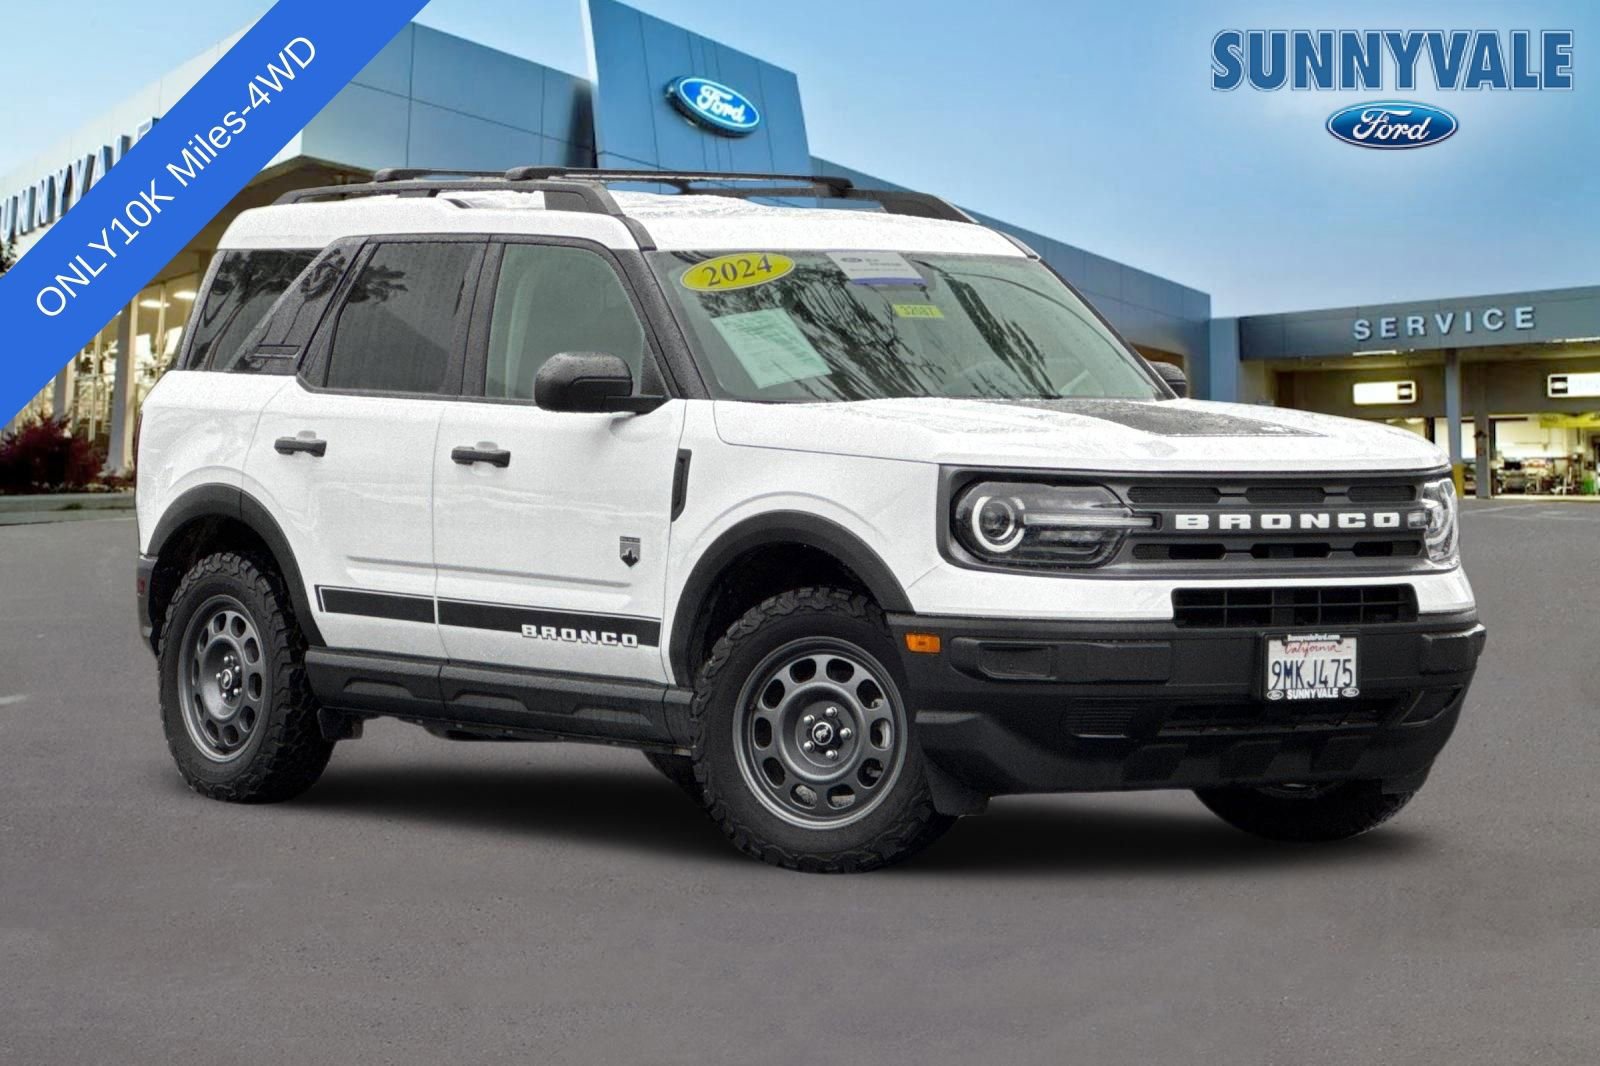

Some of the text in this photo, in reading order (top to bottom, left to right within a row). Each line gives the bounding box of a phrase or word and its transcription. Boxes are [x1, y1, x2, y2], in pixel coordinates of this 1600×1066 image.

[696, 85, 746, 122] Ford
[0, 117, 160, 244] UNNYVA
[702, 254, 773, 286] 2024
[1353, 306, 1536, 341] SERVICE
[1175, 512, 1400, 530] BRONCO
[521, 624, 639, 648] BRONCO
[1272, 659, 1353, 690] 9MKJ475
[1287, 688, 1339, 700] SUNNYVALE
